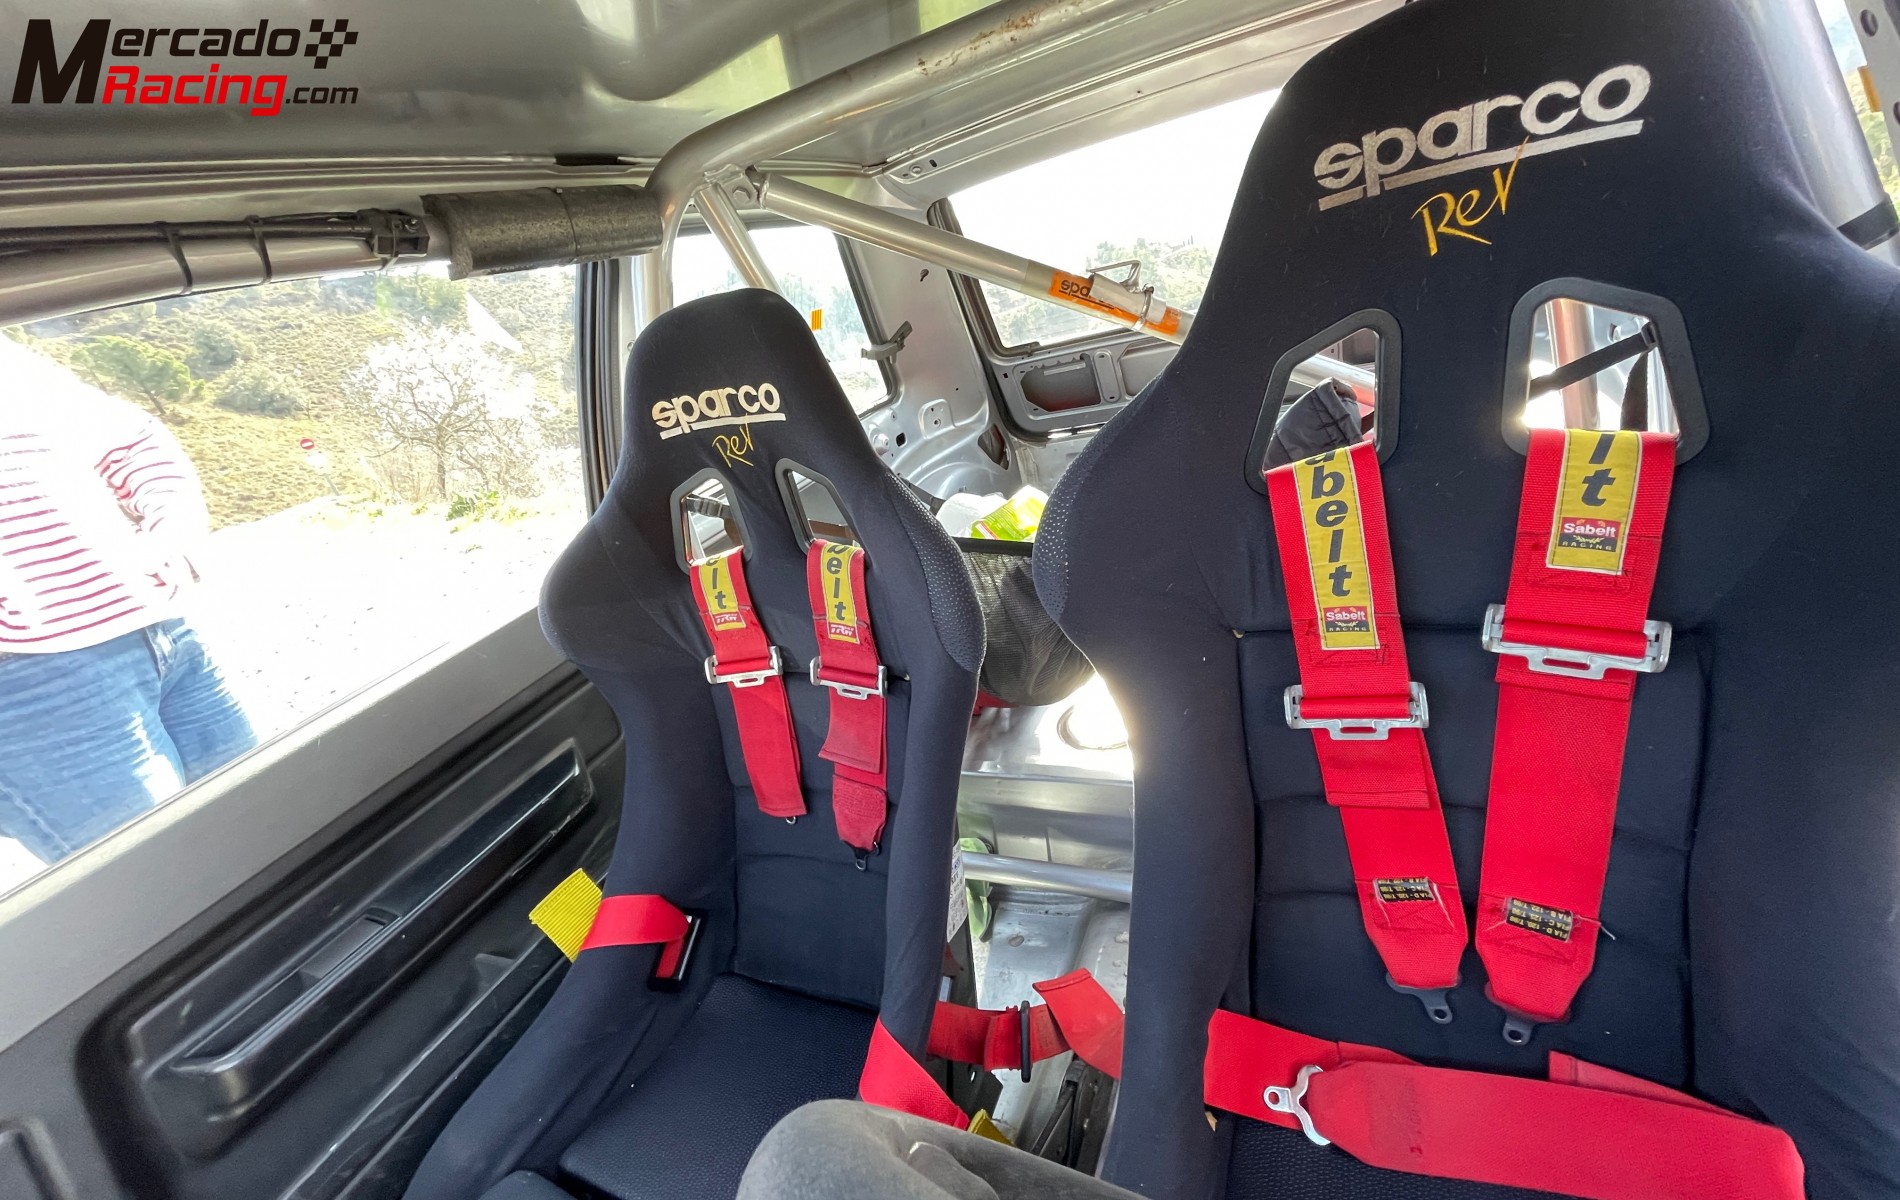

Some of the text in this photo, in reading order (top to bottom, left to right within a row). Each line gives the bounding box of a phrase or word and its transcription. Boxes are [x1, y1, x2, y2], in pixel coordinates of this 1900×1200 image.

[1313, 64, 1651, 198] sparco
[1060, 279, 1092, 298] spa
[652, 383, 781, 434] sparco
[1563, 522, 1617, 538] Sabelt
[1326, 611, 1366, 621] Sabelt
